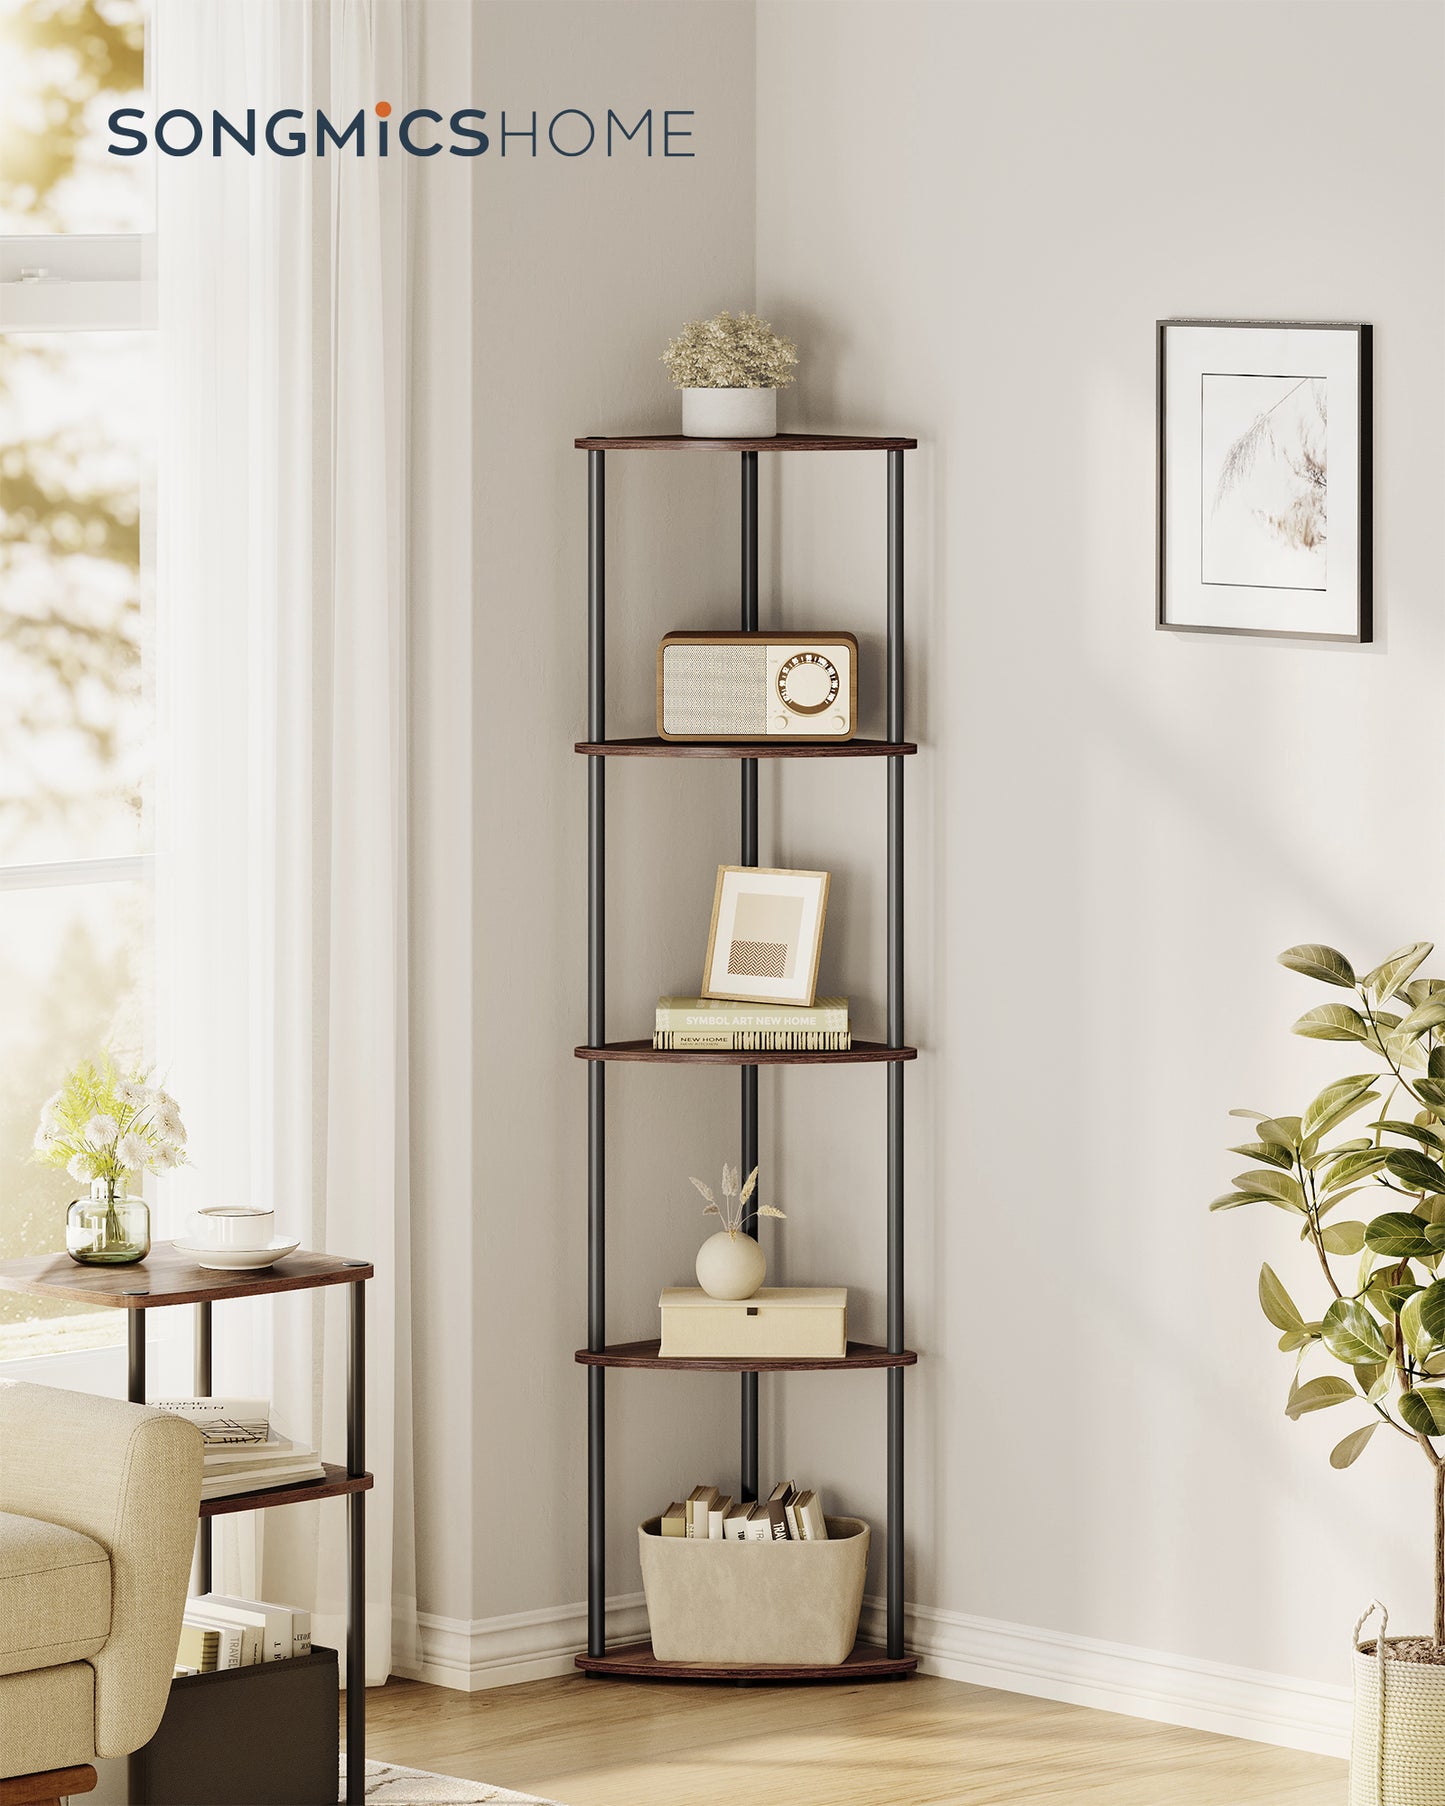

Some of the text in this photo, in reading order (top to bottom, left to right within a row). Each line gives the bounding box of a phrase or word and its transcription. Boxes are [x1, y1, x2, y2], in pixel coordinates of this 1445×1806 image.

[686, 1016, 817, 1026] SYMBOL ART NEW HOME
[755, 1528, 764, 1540] TR
[773, 1522, 788, 1540] TRAV
[228, 1637, 240, 1668] TRAVEL
